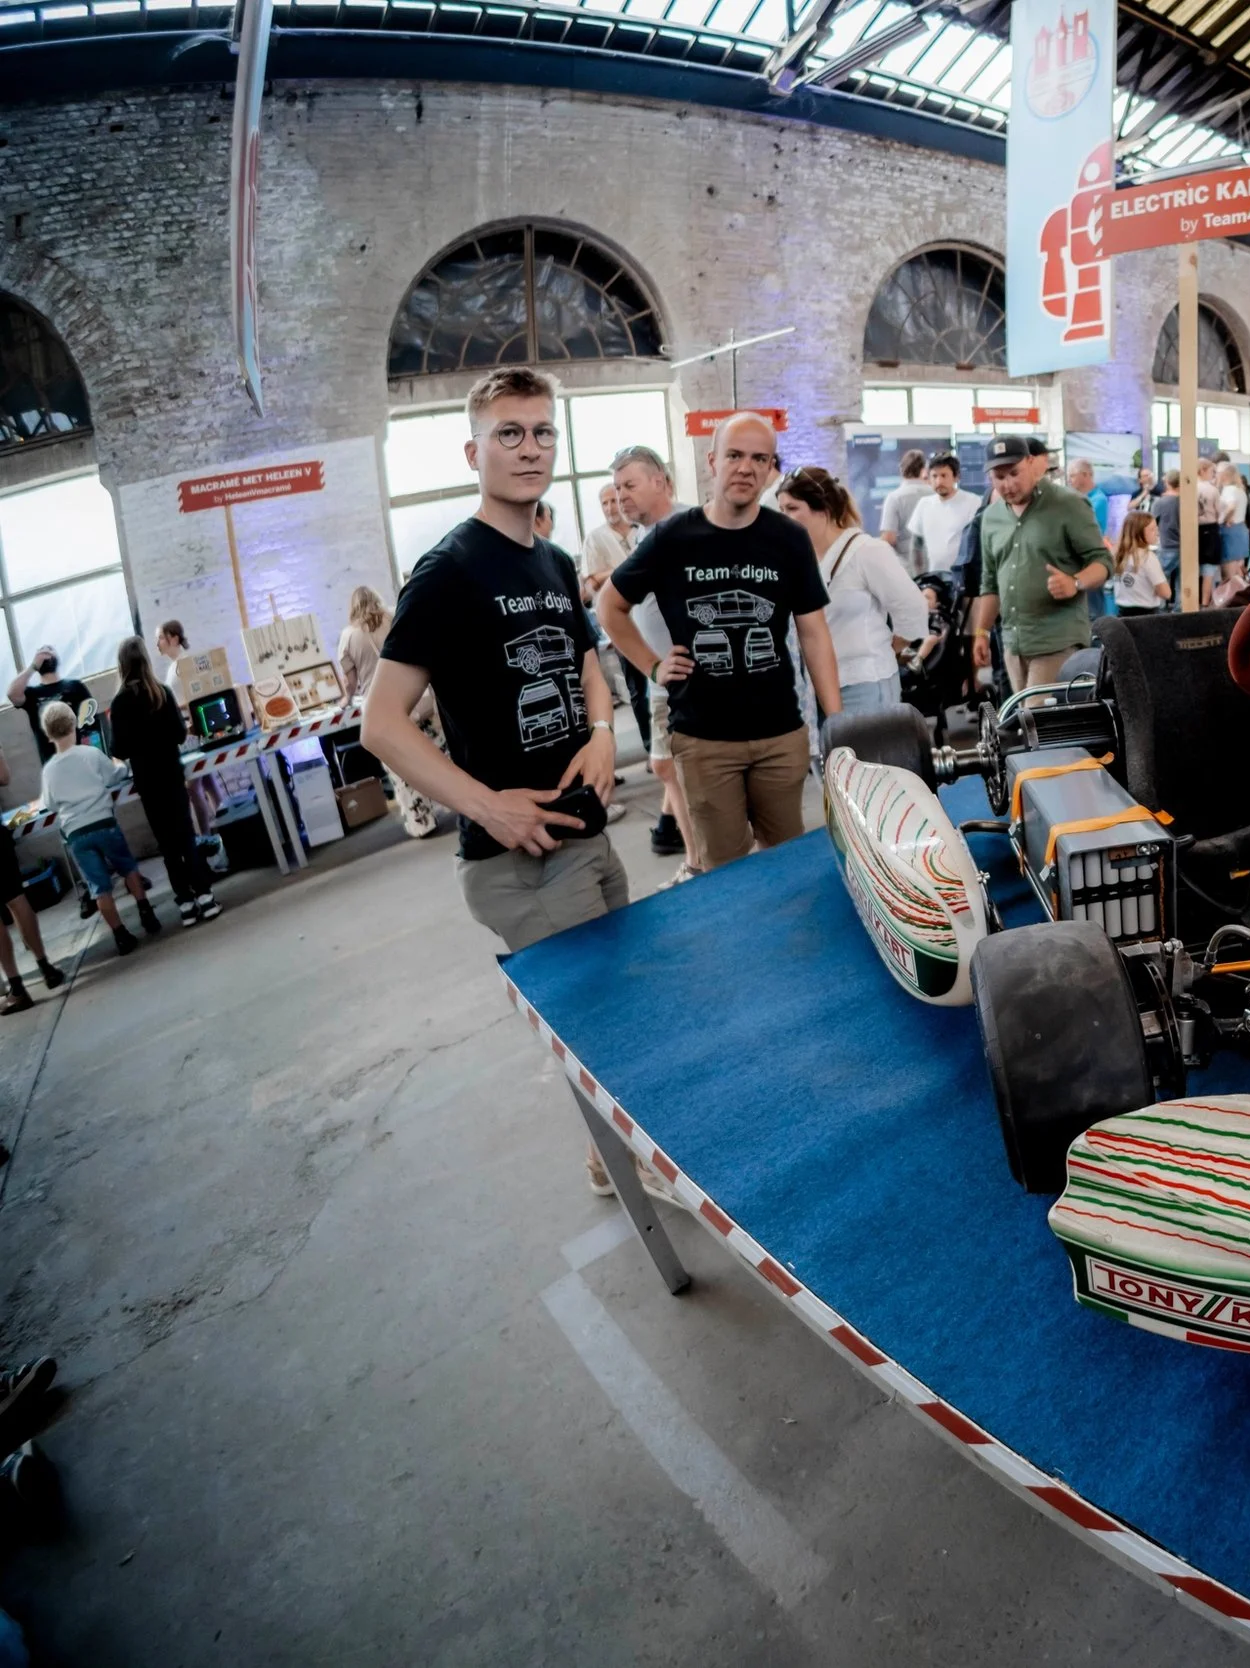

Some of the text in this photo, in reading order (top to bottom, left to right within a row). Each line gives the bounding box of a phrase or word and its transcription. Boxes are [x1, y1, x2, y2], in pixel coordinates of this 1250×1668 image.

[1110, 184, 1209, 219] ELECTRIC
[1180, 216, 1198, 232] by
[190, 467, 312, 494] MACRAMÉ MET HELEEN V
[213, 483, 292, 503] by HeleenVmacramé
